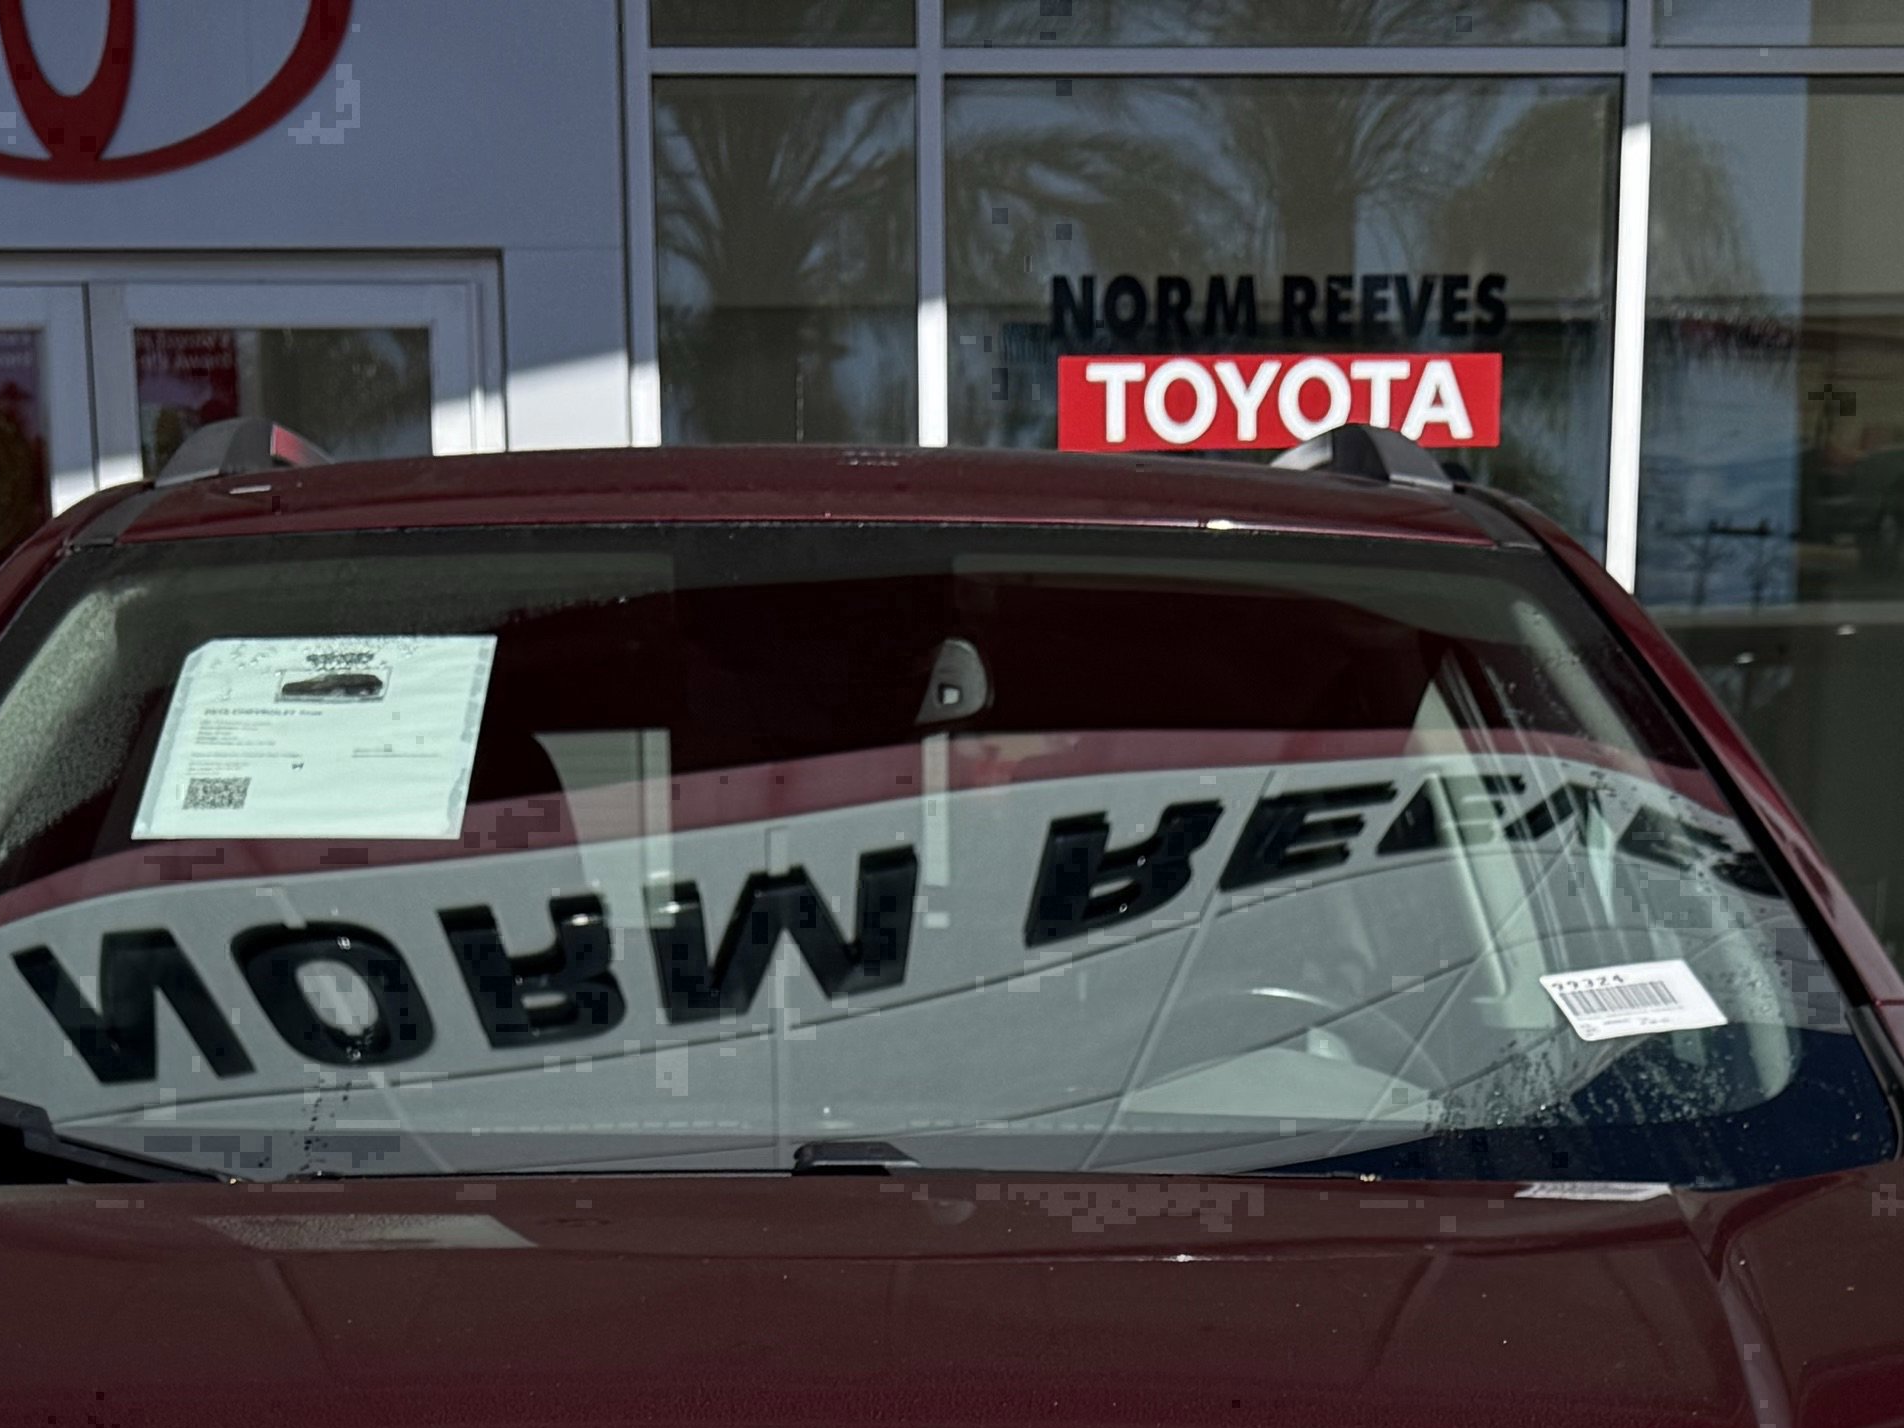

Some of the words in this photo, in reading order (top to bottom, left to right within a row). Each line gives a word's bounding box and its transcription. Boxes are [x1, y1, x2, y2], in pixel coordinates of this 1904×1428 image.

[1051, 275, 1257, 338] NORM
[1281, 274, 1508, 337] REEVES
[1085, 357, 1473, 444] TOYOTA
